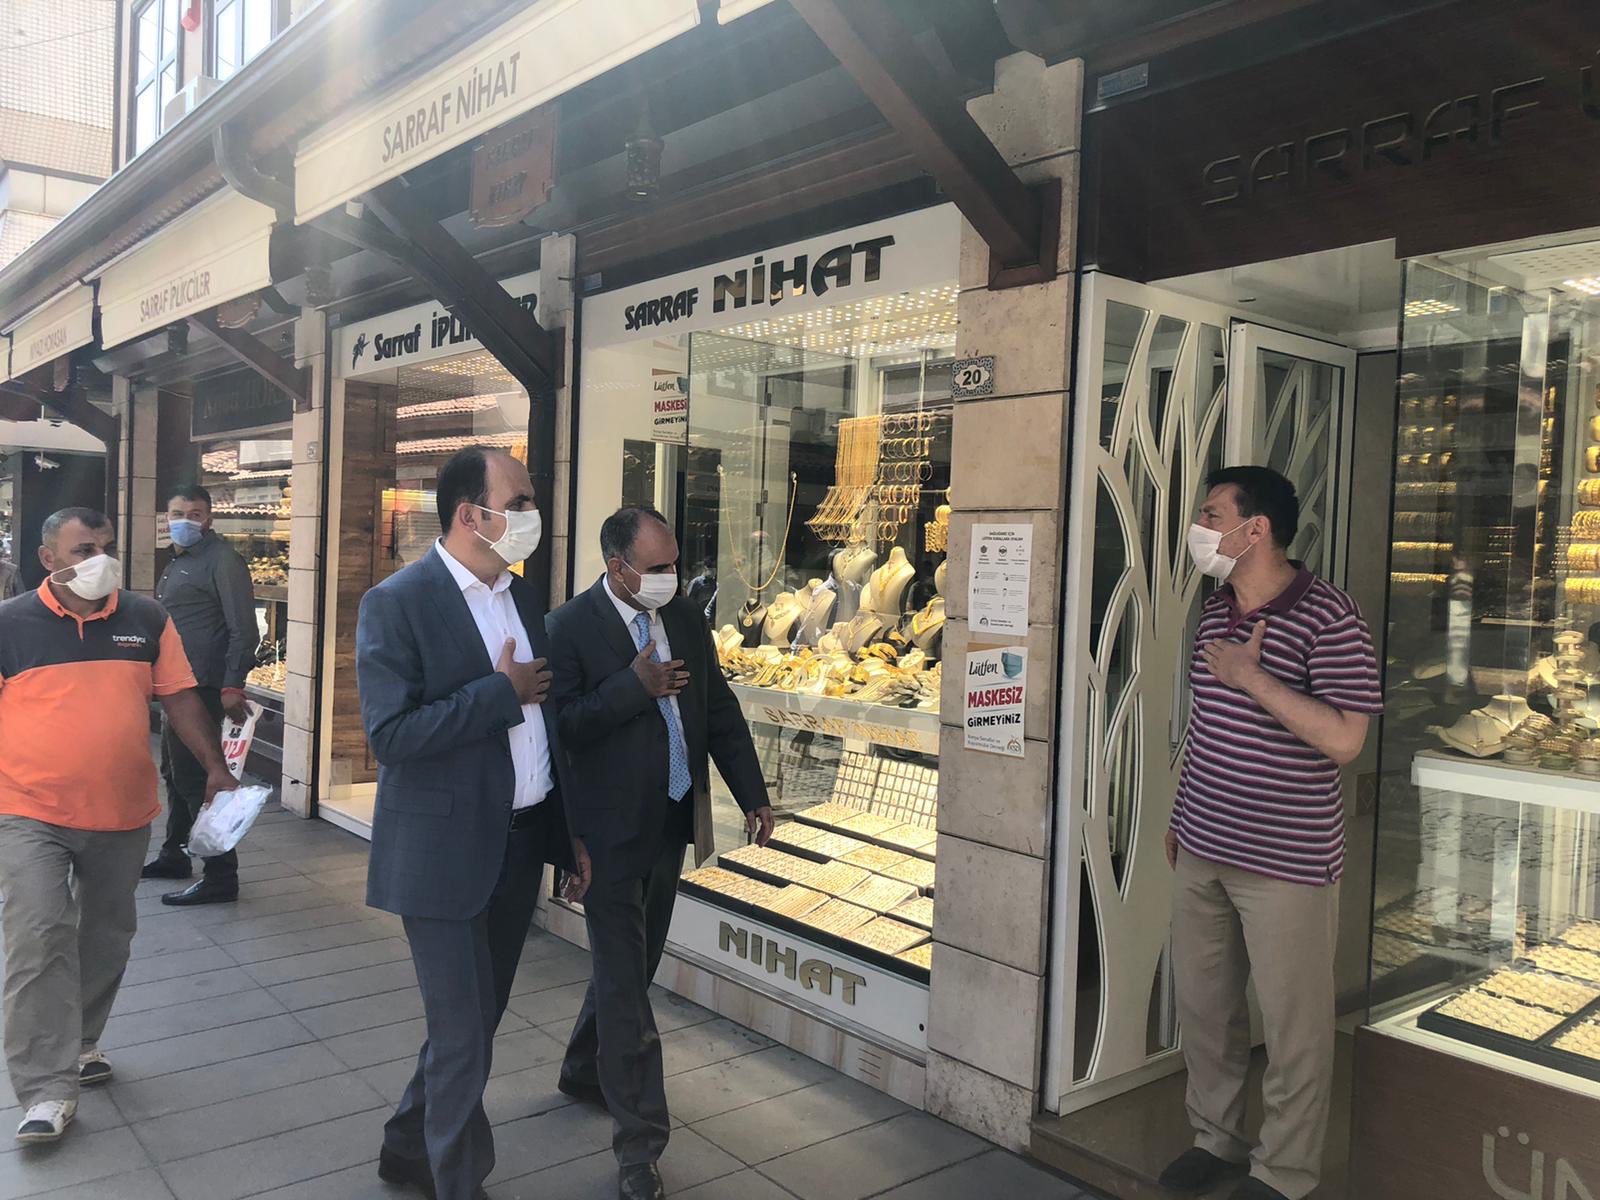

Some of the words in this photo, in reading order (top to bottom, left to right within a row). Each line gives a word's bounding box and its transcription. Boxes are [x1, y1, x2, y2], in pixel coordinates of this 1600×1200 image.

[382, 92, 452, 163] SARRAF
[456, 51, 521, 125] NİHAT
[1201, 77, 1545, 207] SARRAF
[625, 287, 699, 331] SARRAF
[713, 235, 895, 313] NİHAT
[374, 323, 422, 361] Sarraf
[962, 369, 982, 386] 20
[655, 398, 688, 412] MASKESİ
[969, 659, 999, 676] Lütfen
[968, 686, 1023, 708] MASKESİZ
[967, 713, 1021, 727] GİRMEYİNİZ
[719, 920, 867, 1006] NIHAT
